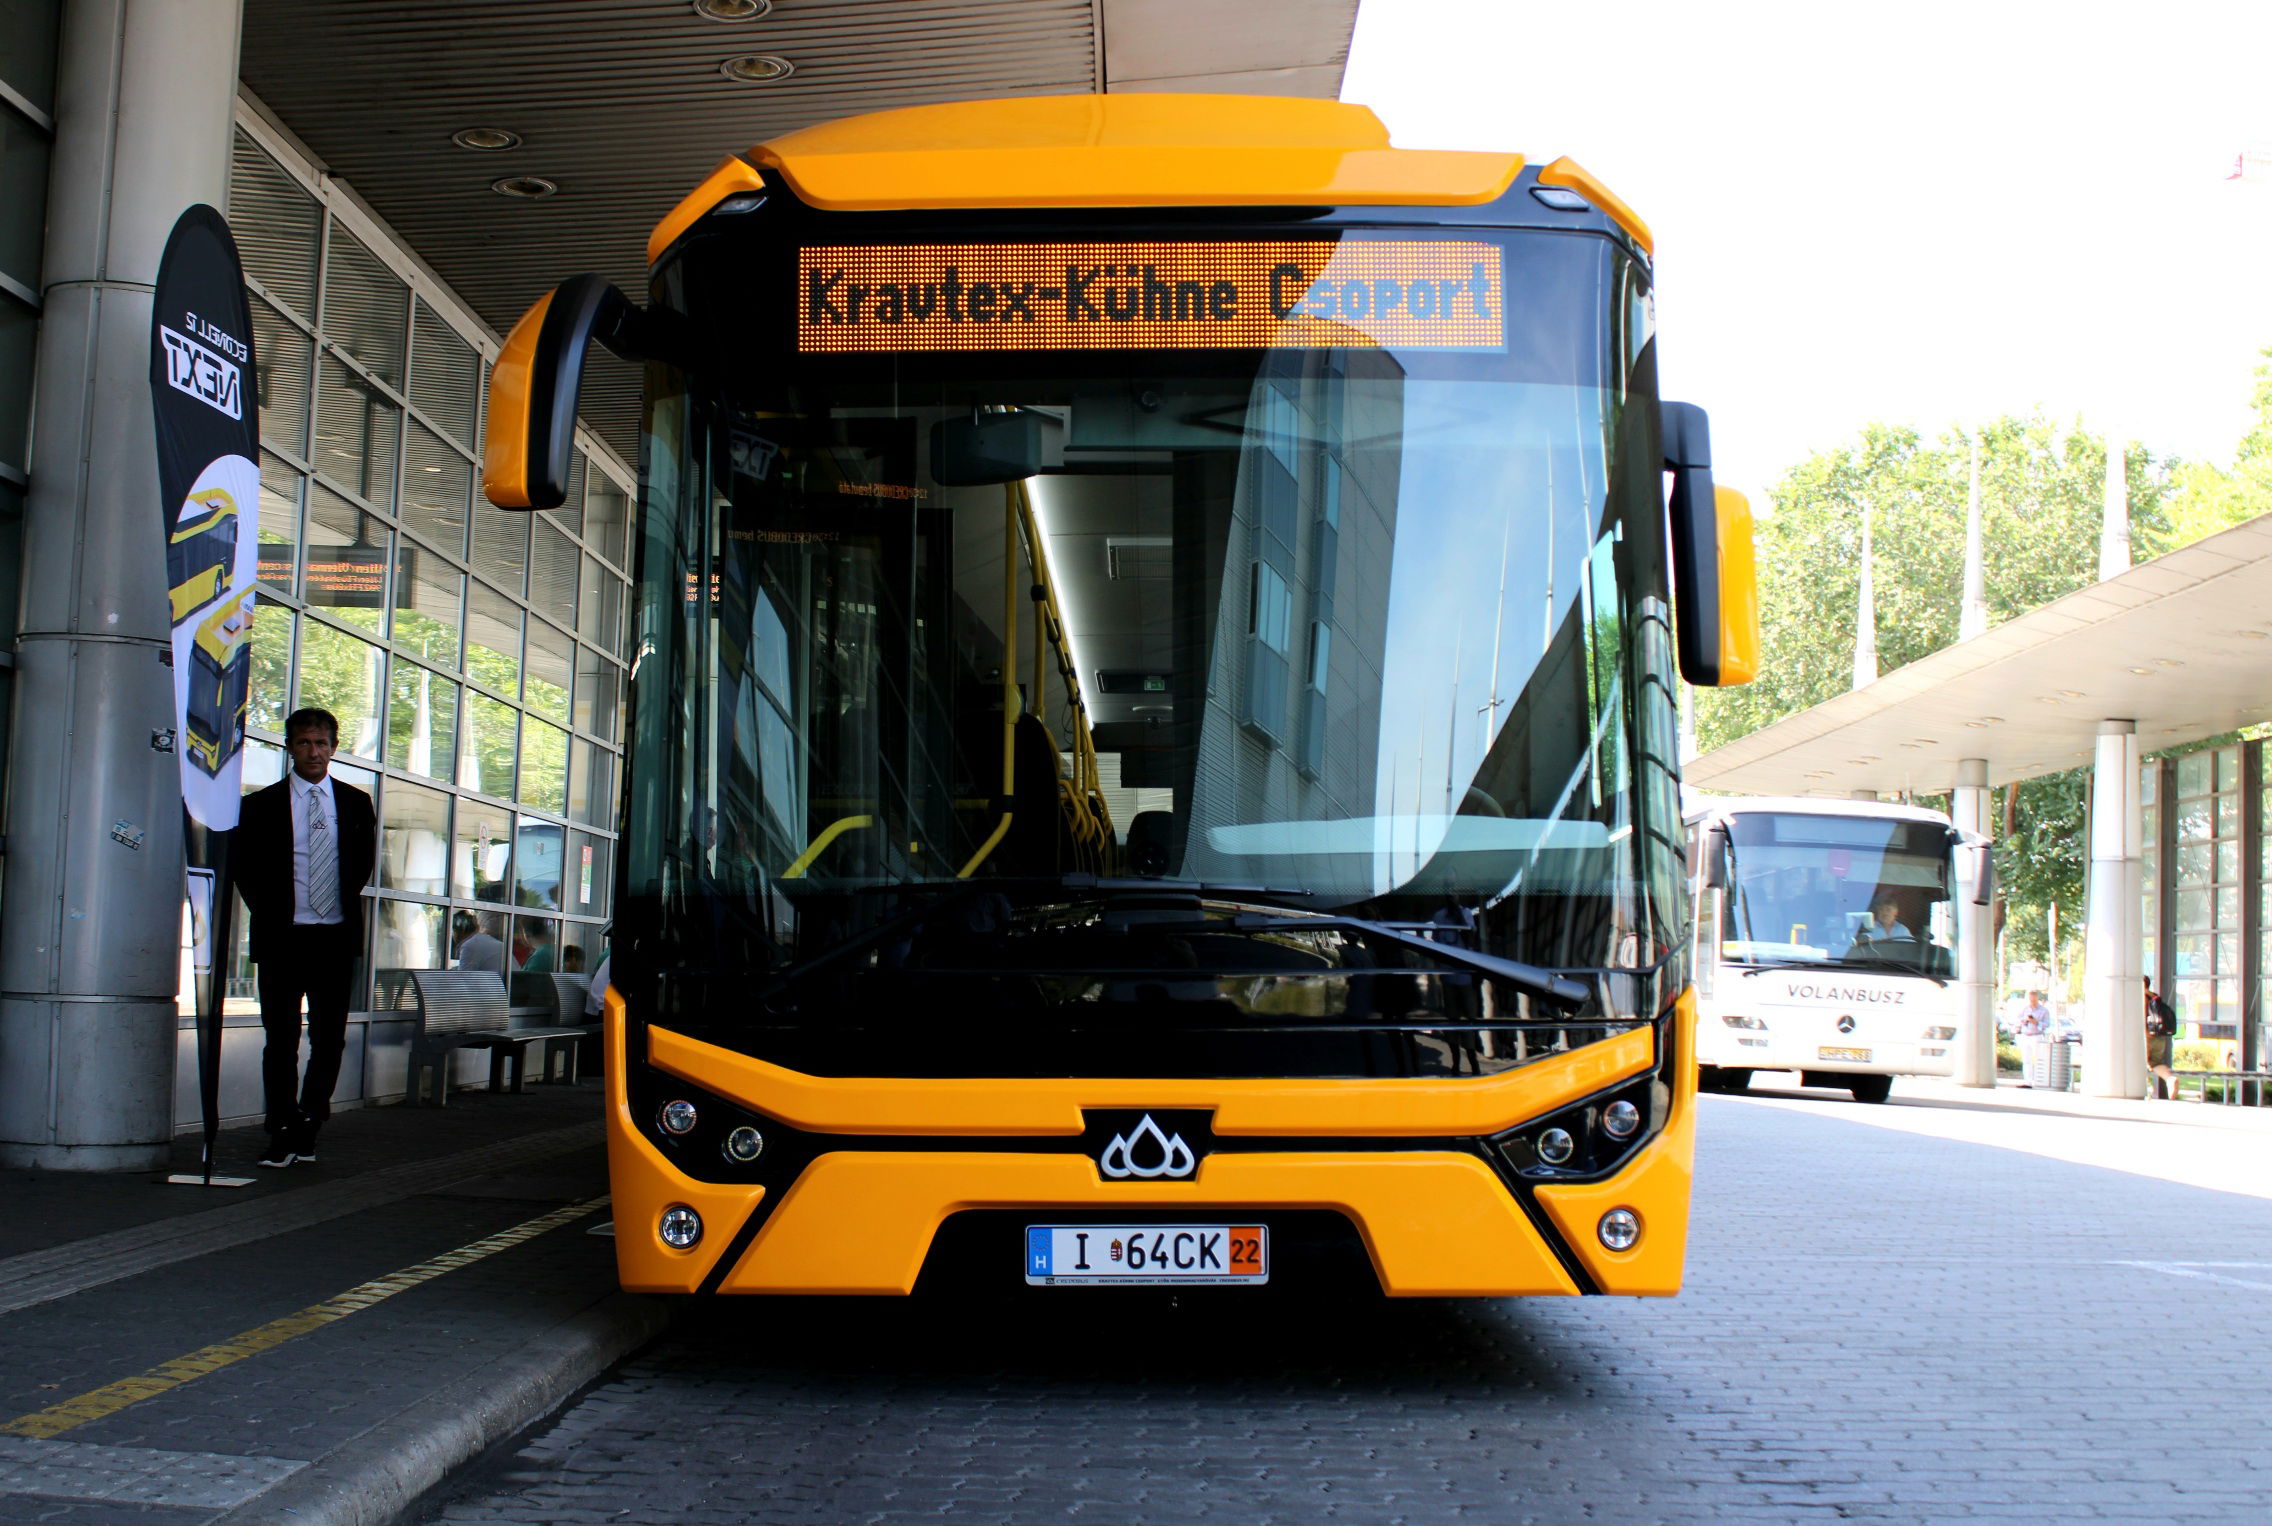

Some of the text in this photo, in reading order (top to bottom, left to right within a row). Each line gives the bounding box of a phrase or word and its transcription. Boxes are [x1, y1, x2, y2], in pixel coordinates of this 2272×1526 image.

[1269, 262, 1490, 320] Csoport
[1035, 1233, 1261, 1270] H I 64CK 22
